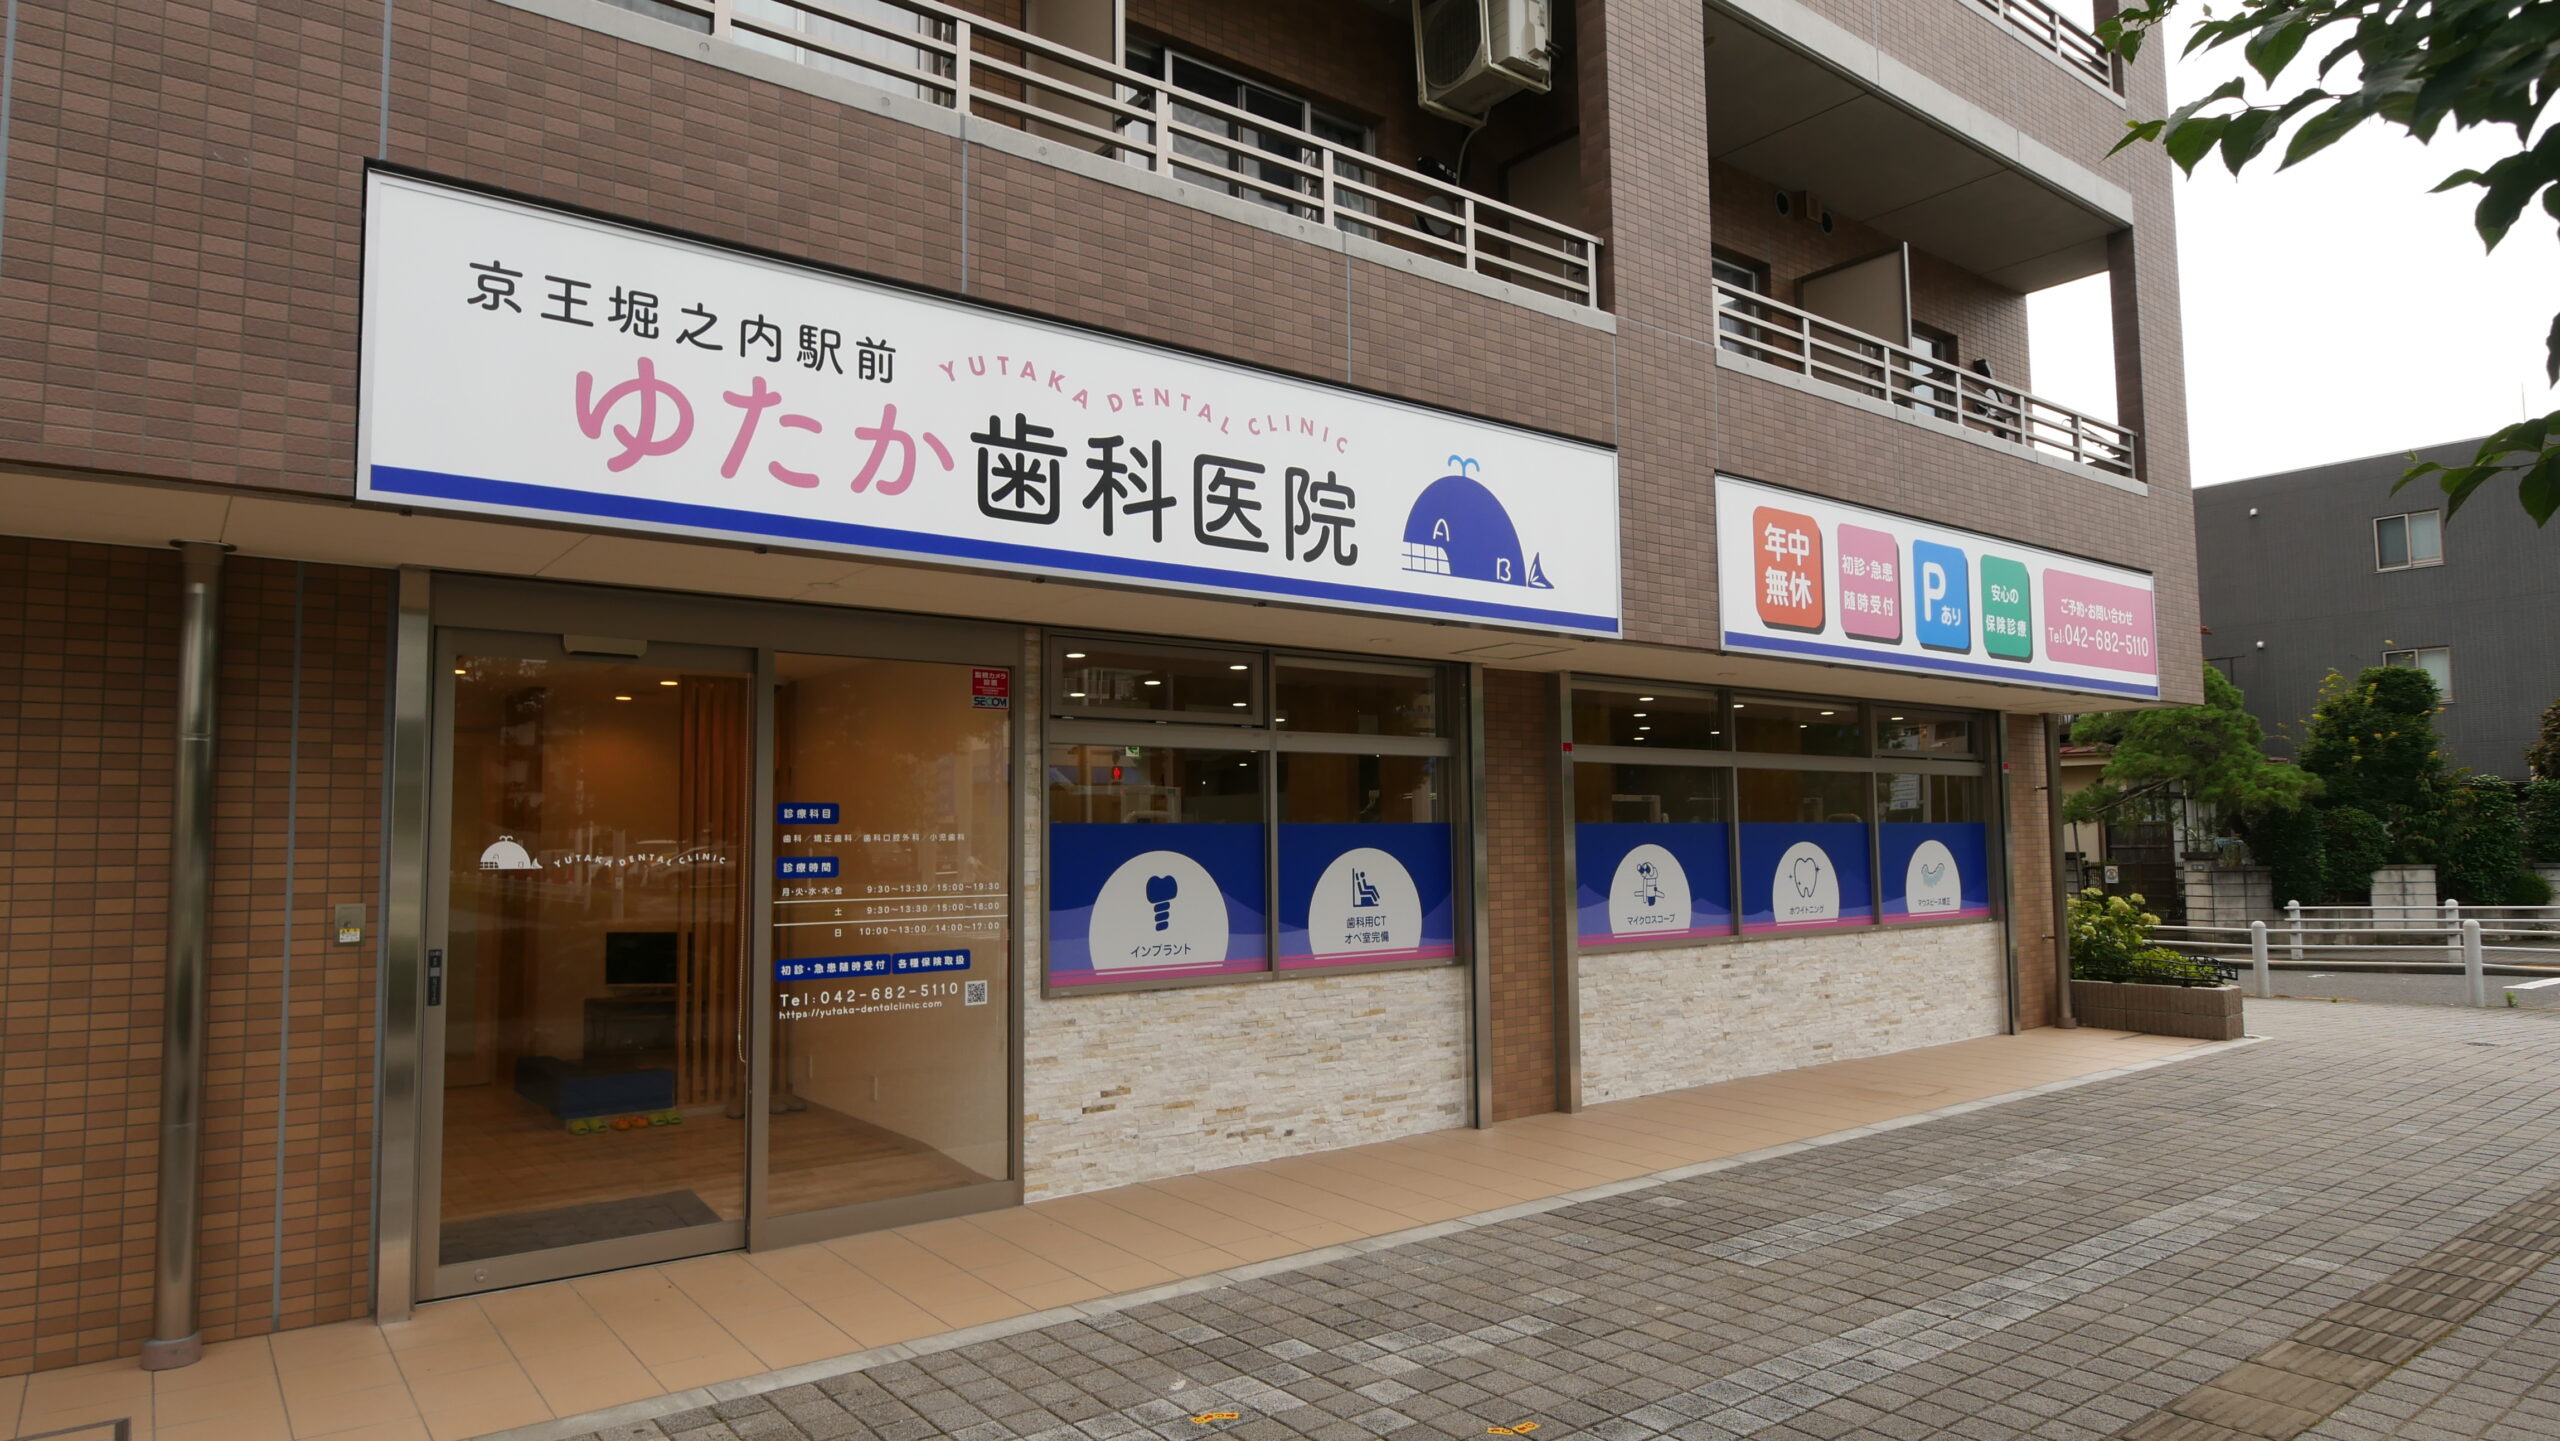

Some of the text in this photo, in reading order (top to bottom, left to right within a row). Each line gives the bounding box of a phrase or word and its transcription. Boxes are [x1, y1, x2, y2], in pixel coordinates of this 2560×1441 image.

[467, 260, 897, 383] 京王堀之内駅前
[938, 355, 1349, 454] YUTAKA DENTAL CLINIC
[576, 357, 1359, 567] ゆたか歯科医院
[1765, 523, 1810, 566] 年中
[1765, 566, 1813, 610] 無休
[1991, 584, 2019, 604] 安心の
[1844, 590, 1894, 617] 随時受付
[1986, 614, 2027, 638] 保険診療
[974, 696, 1007, 708] SECOM
[784, 808, 832, 820] 診療科目
[553, 852, 726, 868] YUTAKA DENTAL CLINIC
[783, 862, 832, 873] 診療時間
[834, 907, 843, 917] 土
[1627, 914, 1675, 925] マイクロスコープ
[1346, 915, 1387, 929] 歯科用CT
[834, 928, 842, 938] 日
[1131, 943, 1191, 958] インプラント
[898, 954, 965, 969] 各種保険取扱
[779, 1000, 943, 1020] https://yutaka-dentalclinic.com
